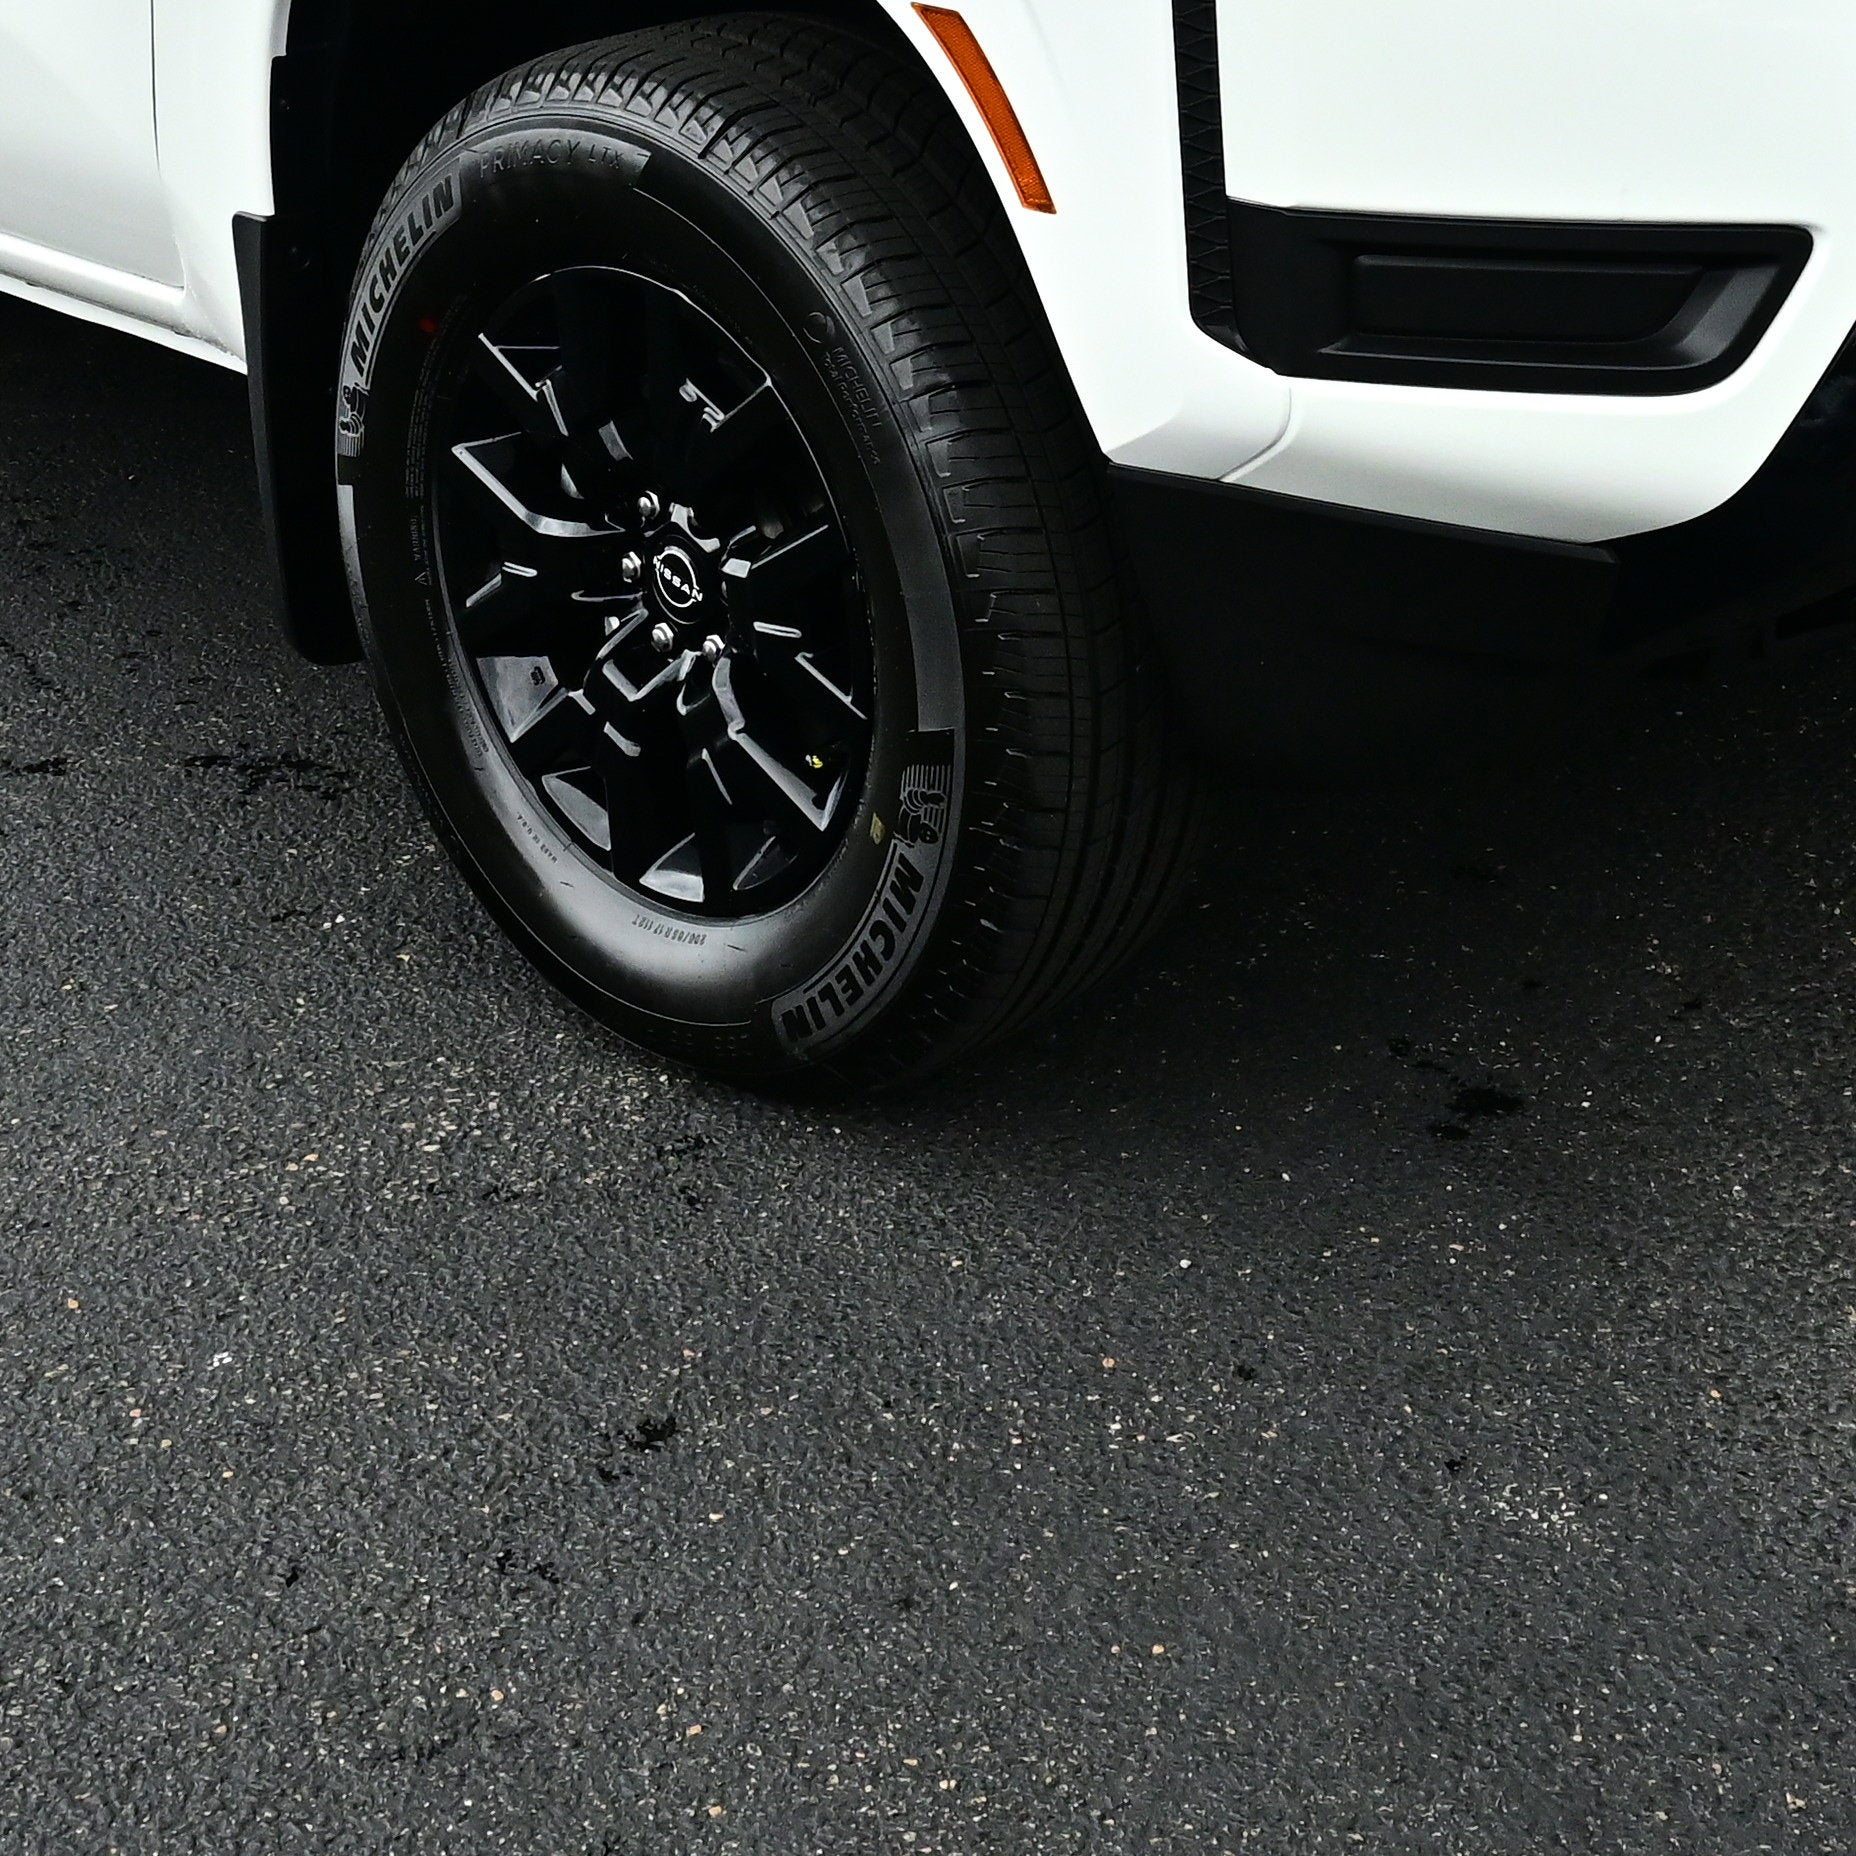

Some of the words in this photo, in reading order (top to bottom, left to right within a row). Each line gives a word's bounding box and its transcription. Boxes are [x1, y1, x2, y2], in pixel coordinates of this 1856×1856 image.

[479, 138, 581, 179] PRIMACY
[587, 142, 625, 170] LTX
[350, 174, 454, 377] MICHELIN
[831, 346, 884, 428] MICHELIN
[652, 555, 704, 602] NISSAN
[780, 851, 925, 1042] MICHELIN
